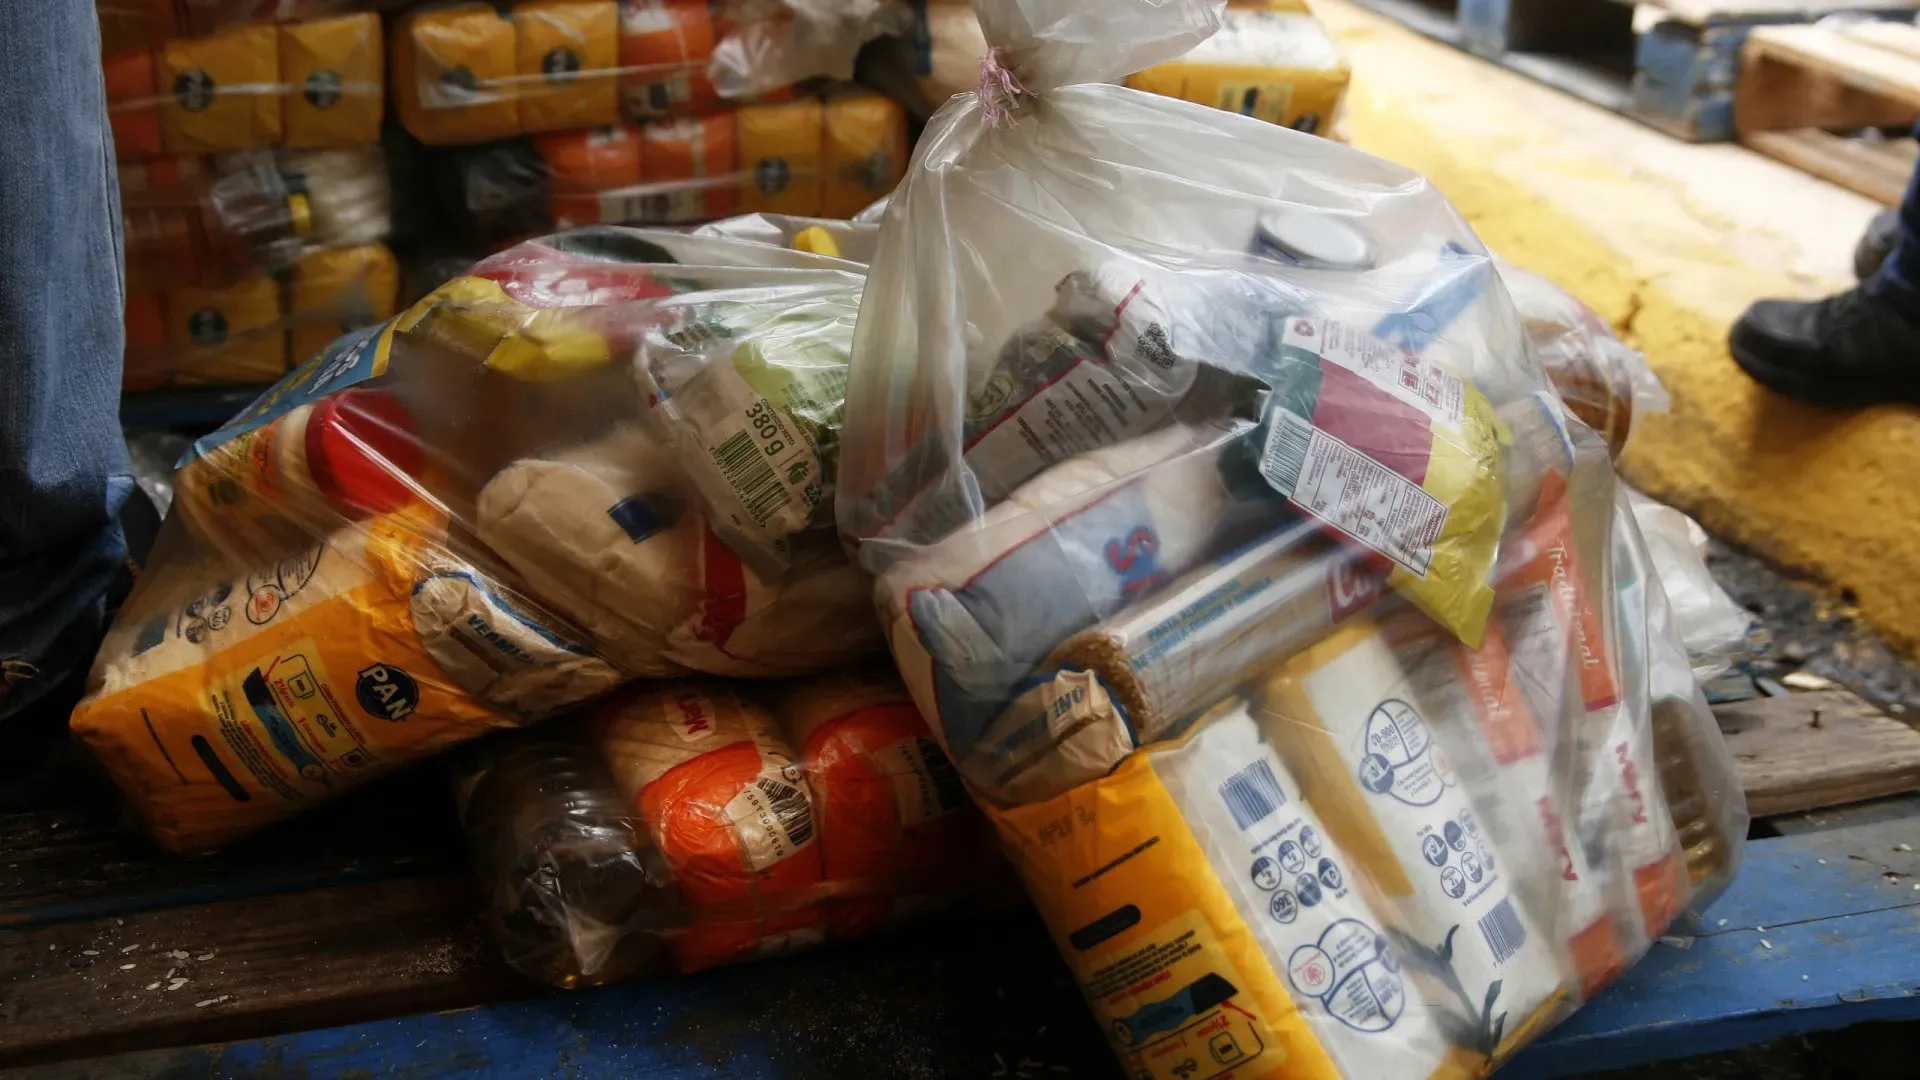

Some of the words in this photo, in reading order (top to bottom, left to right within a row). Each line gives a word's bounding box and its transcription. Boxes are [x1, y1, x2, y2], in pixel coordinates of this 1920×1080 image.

[743, 400, 780, 442] 380
[762, 436, 786, 459] g
[361, 663, 415, 722] PAN
[1270, 892, 1292, 913] 360
